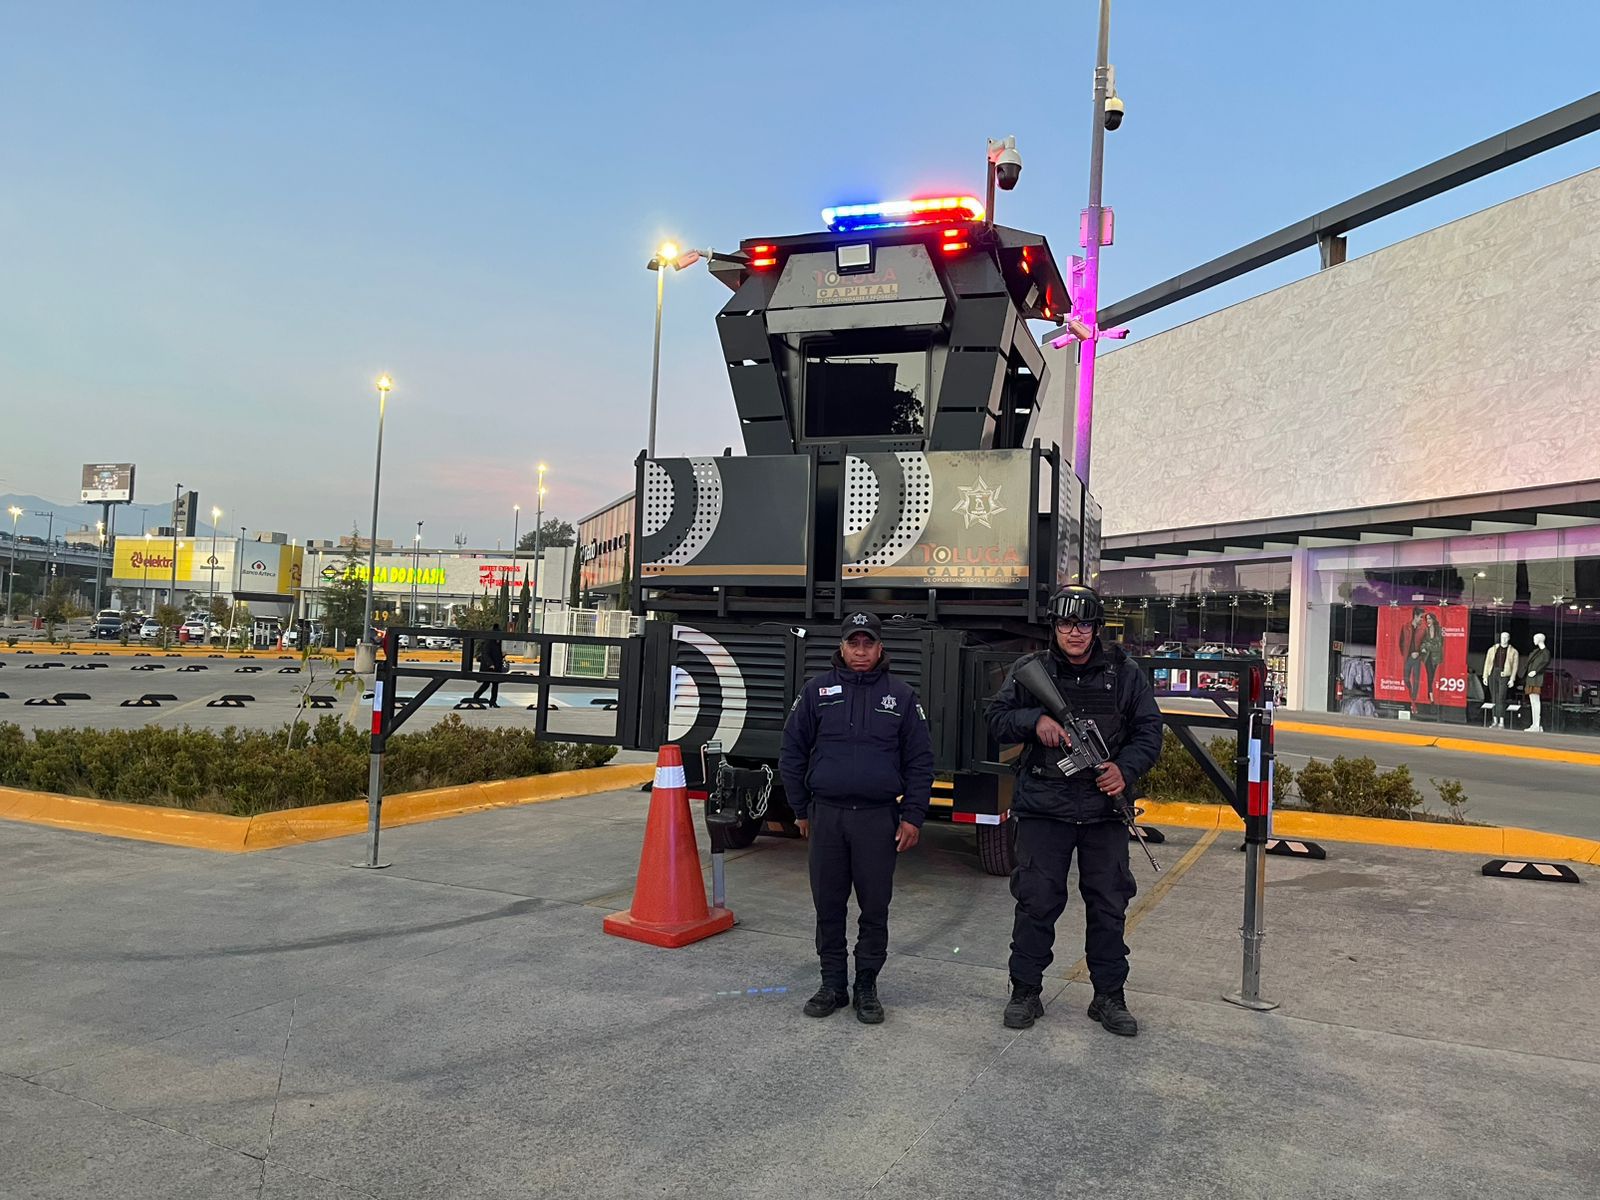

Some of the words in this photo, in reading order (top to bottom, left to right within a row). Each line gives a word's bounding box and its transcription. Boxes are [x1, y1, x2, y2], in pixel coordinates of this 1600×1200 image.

[819, 285, 896, 297] CAPITAL
[919, 543, 1020, 564] TOLUCA
[391, 566, 406, 583] DO
[407, 567, 446, 585] BRASIL
[927, 566, 1018, 576] CAPITAL
